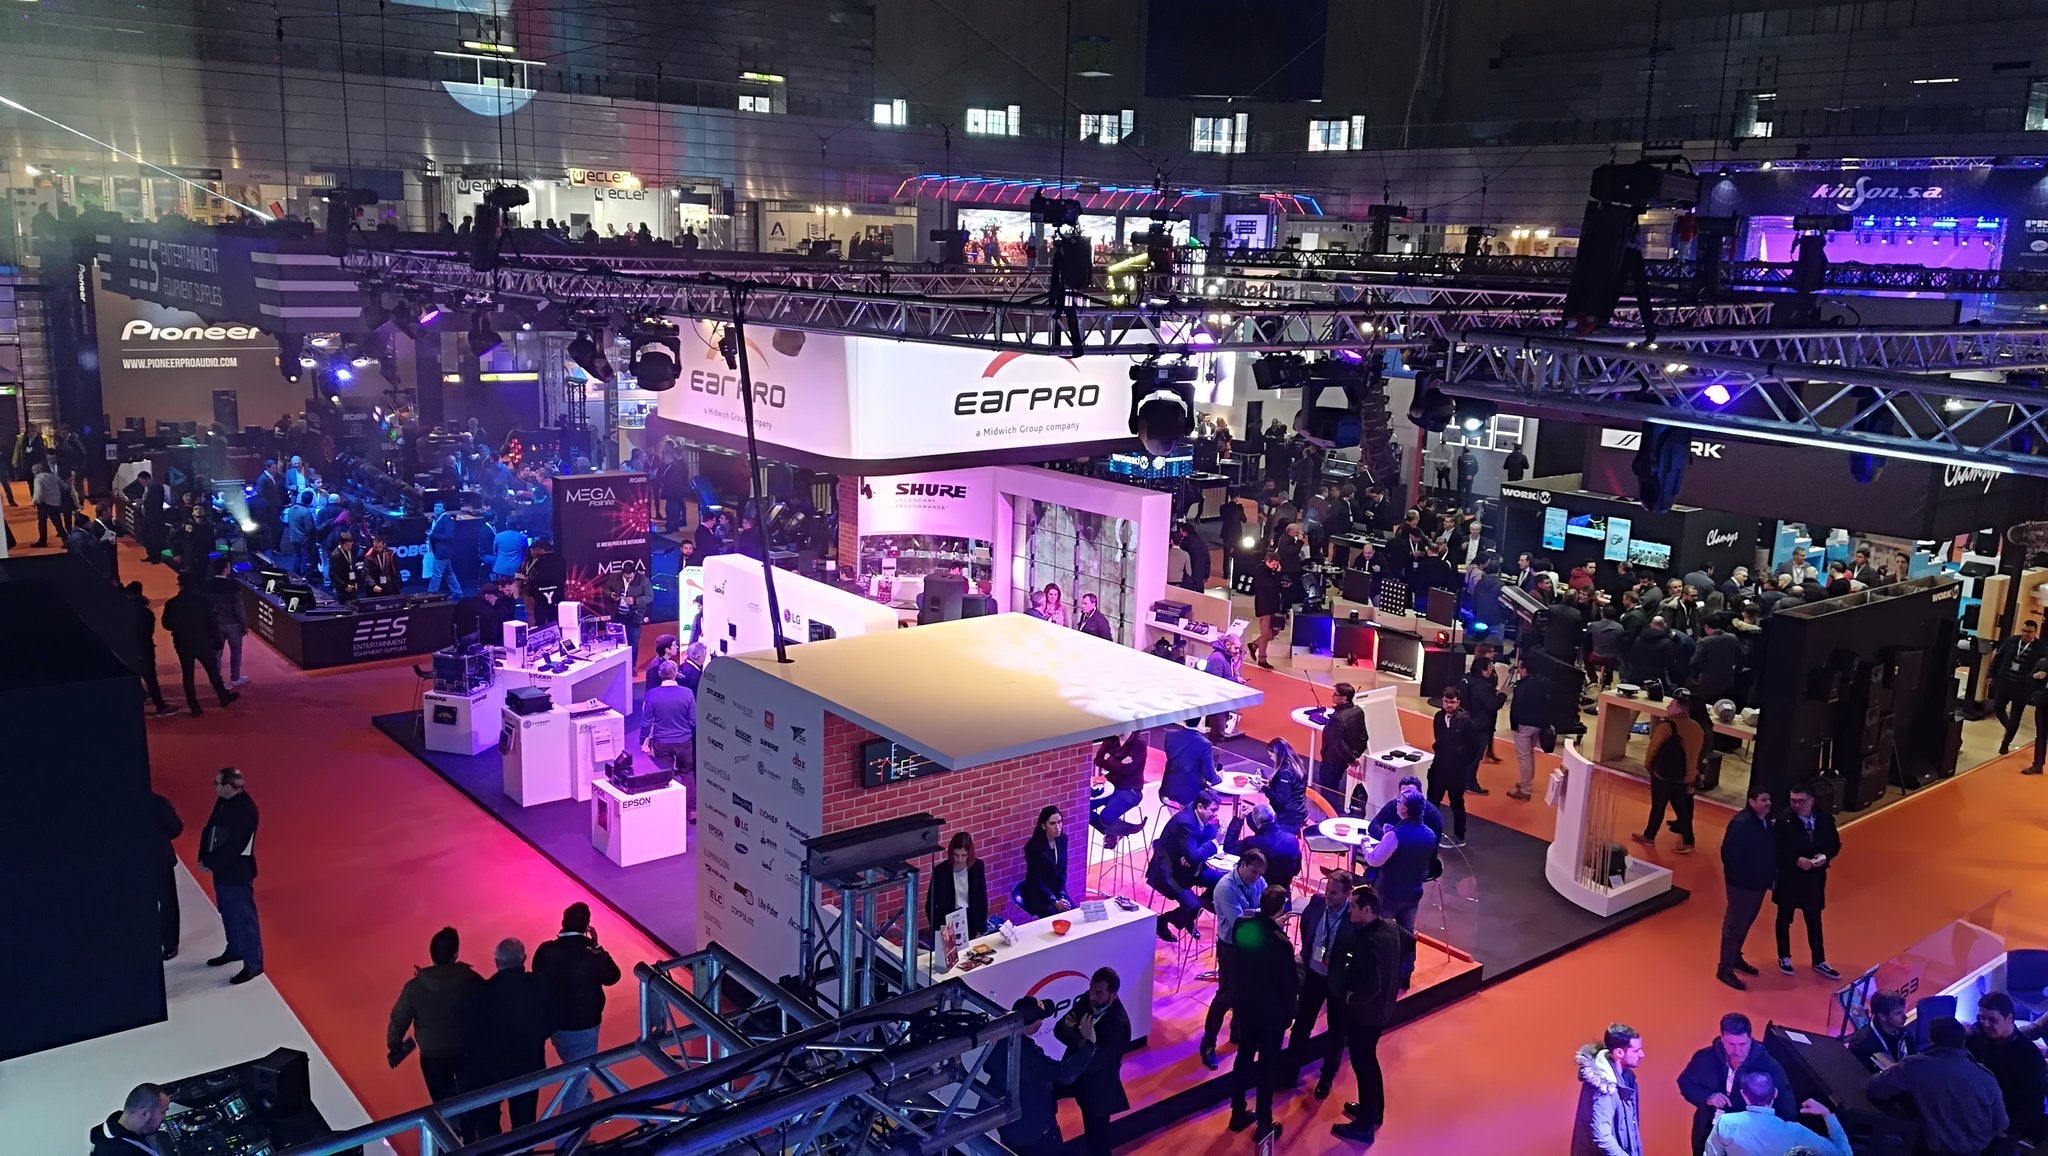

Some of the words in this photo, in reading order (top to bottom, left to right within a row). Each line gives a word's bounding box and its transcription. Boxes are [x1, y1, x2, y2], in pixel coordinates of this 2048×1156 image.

[608, 188, 649, 200] ecler
[160, 241, 219, 274] ENTERTAINMENT
[77, 263, 87, 304] Pioneer
[163, 276, 194, 301] EQUIPMENT
[194, 283, 223, 307] SUPPLIES
[121, 319, 260, 341] Pioneer
[122, 357, 238, 370] WWW.PIONEERPROAUDIO.COM
[708, 407, 730, 420] Midwich
[975, 429, 981, 438] a
[983, 425, 1018, 437] Midwich
[1019, 424, 1044, 435] Group
[1045, 421, 1081, 432] company
[566, 486, 616, 503] MEGA
[895, 483, 967, 499] SHURE
[588, 499, 615, 507] Pointe
[543, 591, 555, 604] Y
[791, 612, 801, 625] LG
[353, 616, 410, 642] EES
[353, 638, 407, 651] ENTERTAINMENT
[622, 797, 651, 809] EPSON
[708, 823, 724, 839] EPSON
[741, 821, 749, 832] LG
[785, 821, 810, 840] Panasonic
[710, 889, 723, 905] ELC
